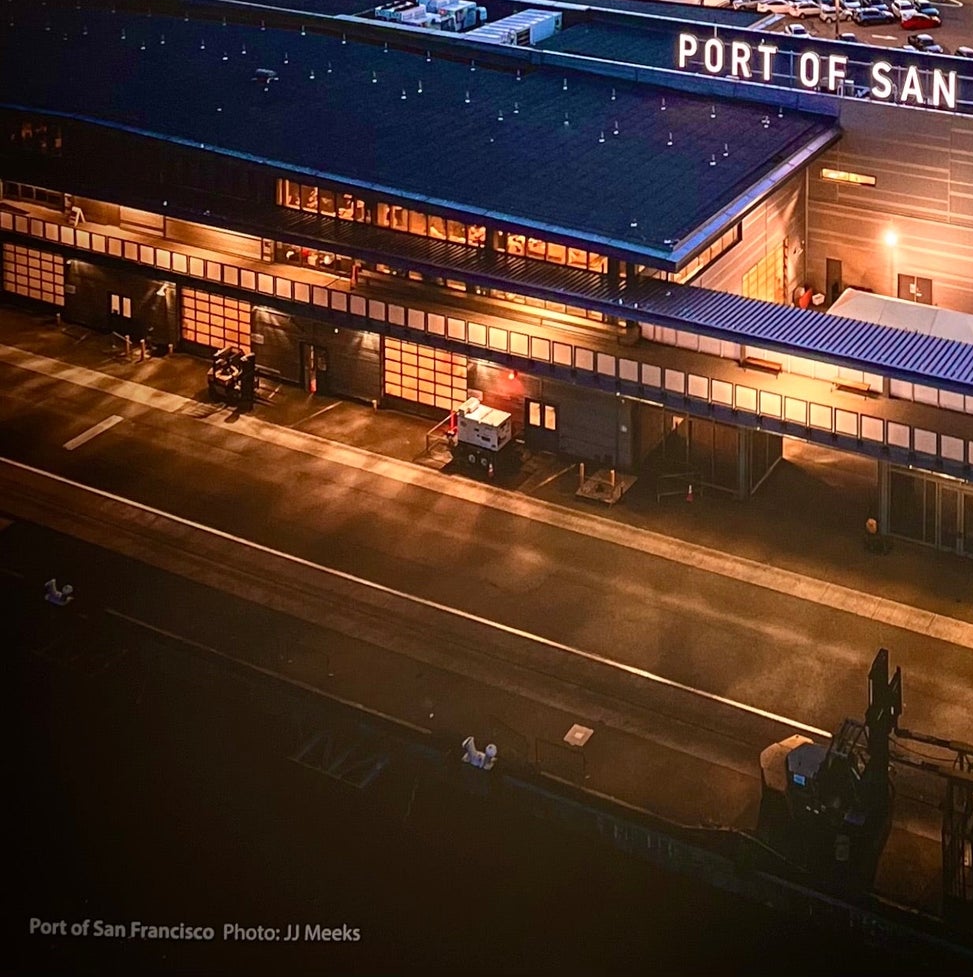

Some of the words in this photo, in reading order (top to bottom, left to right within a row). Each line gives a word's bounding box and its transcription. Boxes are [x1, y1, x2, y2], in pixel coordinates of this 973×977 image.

[678, 32, 779, 82] PORT
[799, 50, 849, 92] OF
[870, 60, 957, 110] SAN
